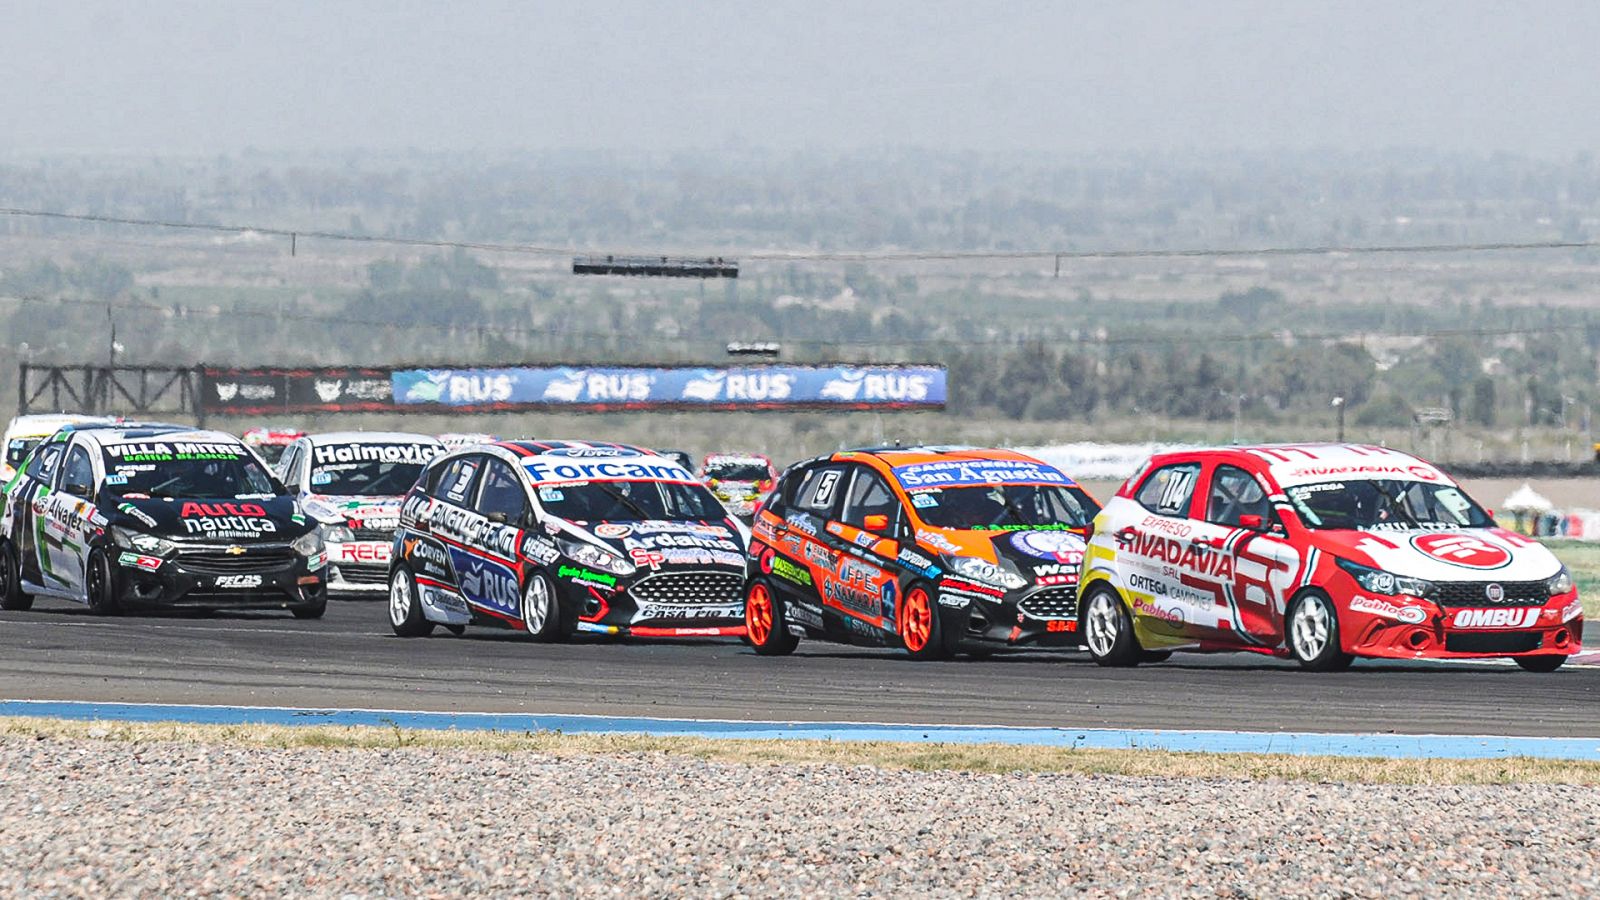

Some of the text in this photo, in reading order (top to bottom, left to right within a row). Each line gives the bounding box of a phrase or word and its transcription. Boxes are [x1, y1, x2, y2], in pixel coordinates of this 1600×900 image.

[450, 376, 513, 402] RUS
[588, 375, 652, 399] RUS
[726, 375, 792, 399] RUS
[864, 375, 929, 400] RUS
[43, 450, 59, 472] 4
[106, 442, 248, 457] VILLA MITRE
[451, 464, 475, 494] 3
[523, 462, 693, 481] Forcam
[900, 471, 956, 486] San
[816, 473, 839, 501] 5
[1160, 470, 1193, 509] 114
[48, 498, 83, 531] Alvarez
[181, 501, 266, 517] Auto
[1140, 515, 1193, 537] EXPRESO
[629, 548, 666, 571] SP
[1116, 527, 1233, 581] RIVADAVIA
[483, 569, 519, 611] RUS
[1129, 573, 1213, 611] ORTEGA CAMIONES
[1353, 597, 1419, 622] Pabloso
[1453, 609, 1523, 628] OMBU
